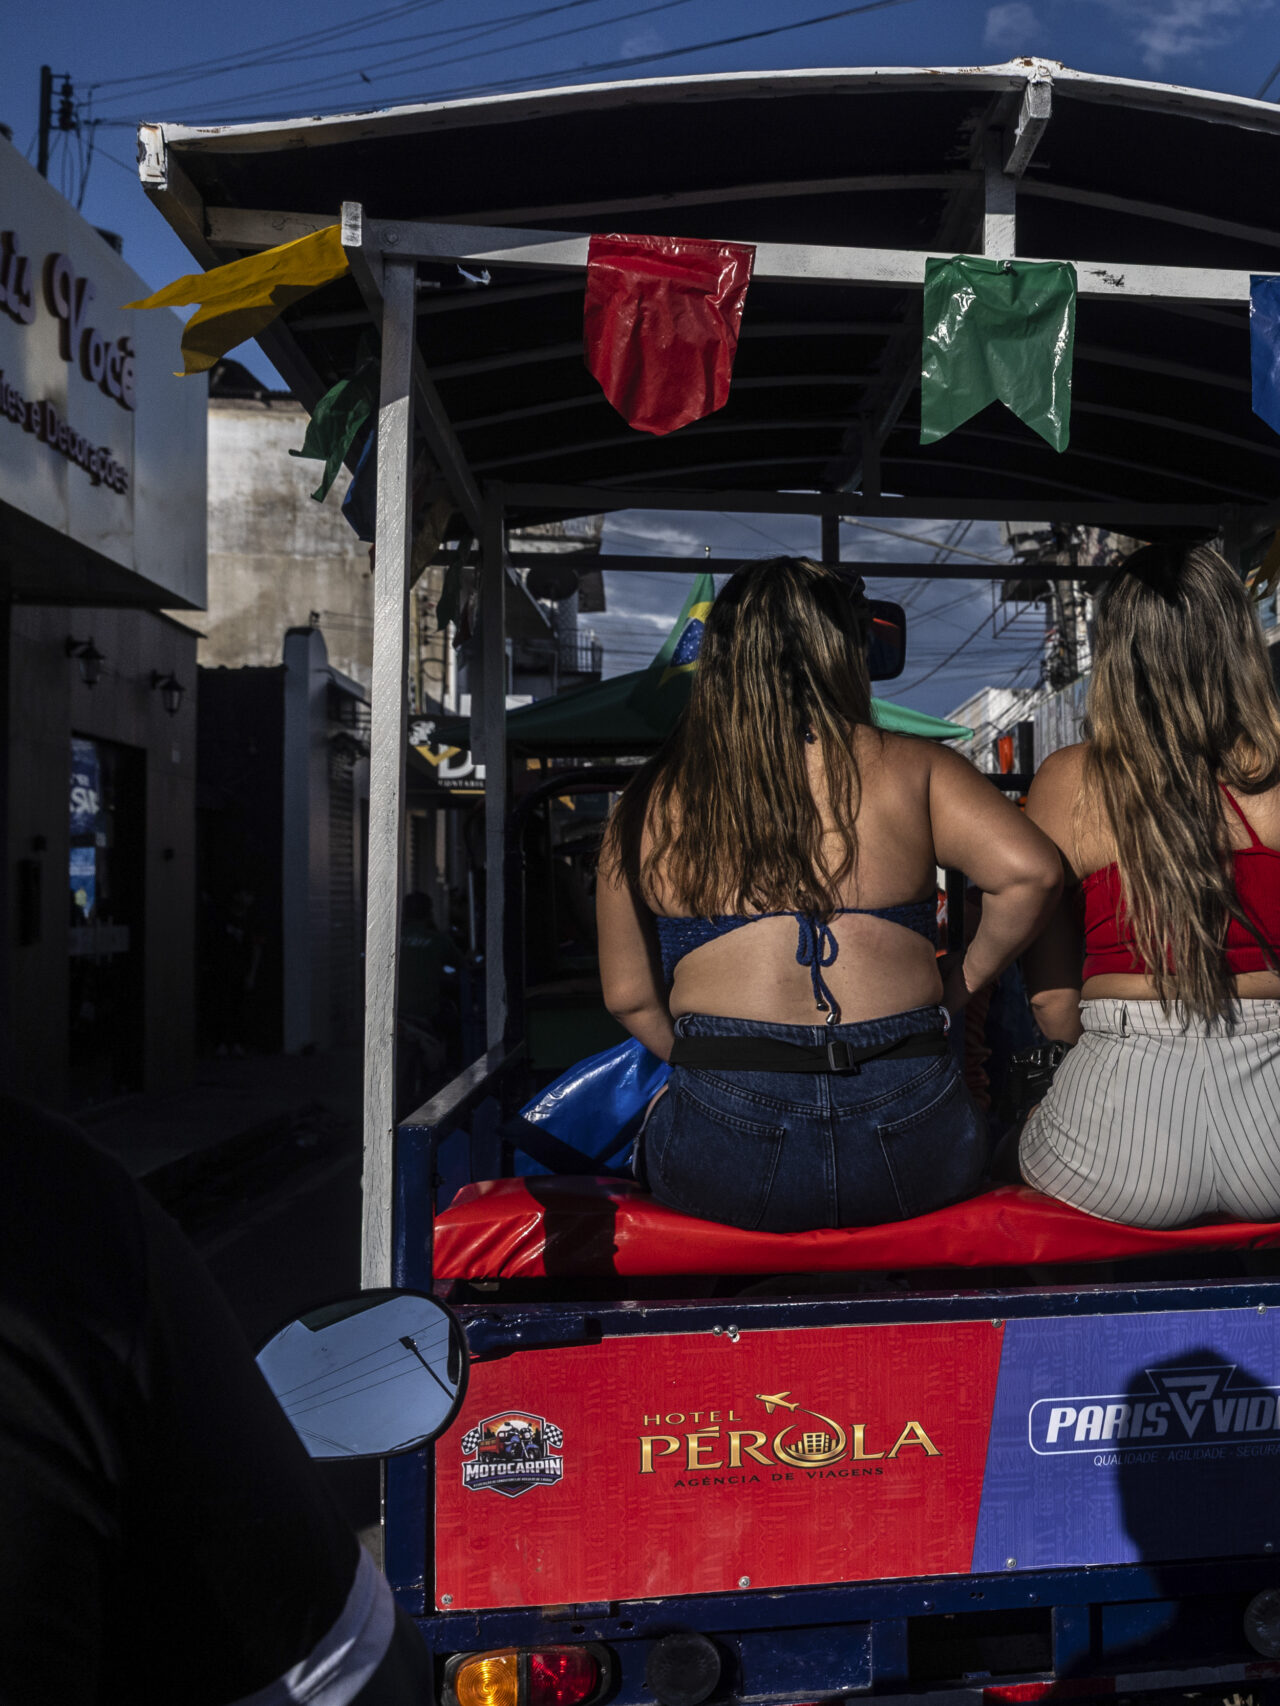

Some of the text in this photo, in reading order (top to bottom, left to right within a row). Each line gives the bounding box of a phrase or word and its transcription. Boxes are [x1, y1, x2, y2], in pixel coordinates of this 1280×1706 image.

[42, 252, 136, 412] Você
[38, 401, 129, 494] Decorações
[643, 1410, 742, 1426] HOTEL
[1046, 1402, 1168, 1443] PARIS
[638, 1420, 943, 1474] PÉROLA
[1094, 1449, 1157, 1467] QUALIDADE
[1168, 1446, 1226, 1462] AGILIDADE
[466, 1459, 561, 1482] MOTOCARPIN
[674, 1467, 884, 1488] AGÊNCIA DE VIAGENS
